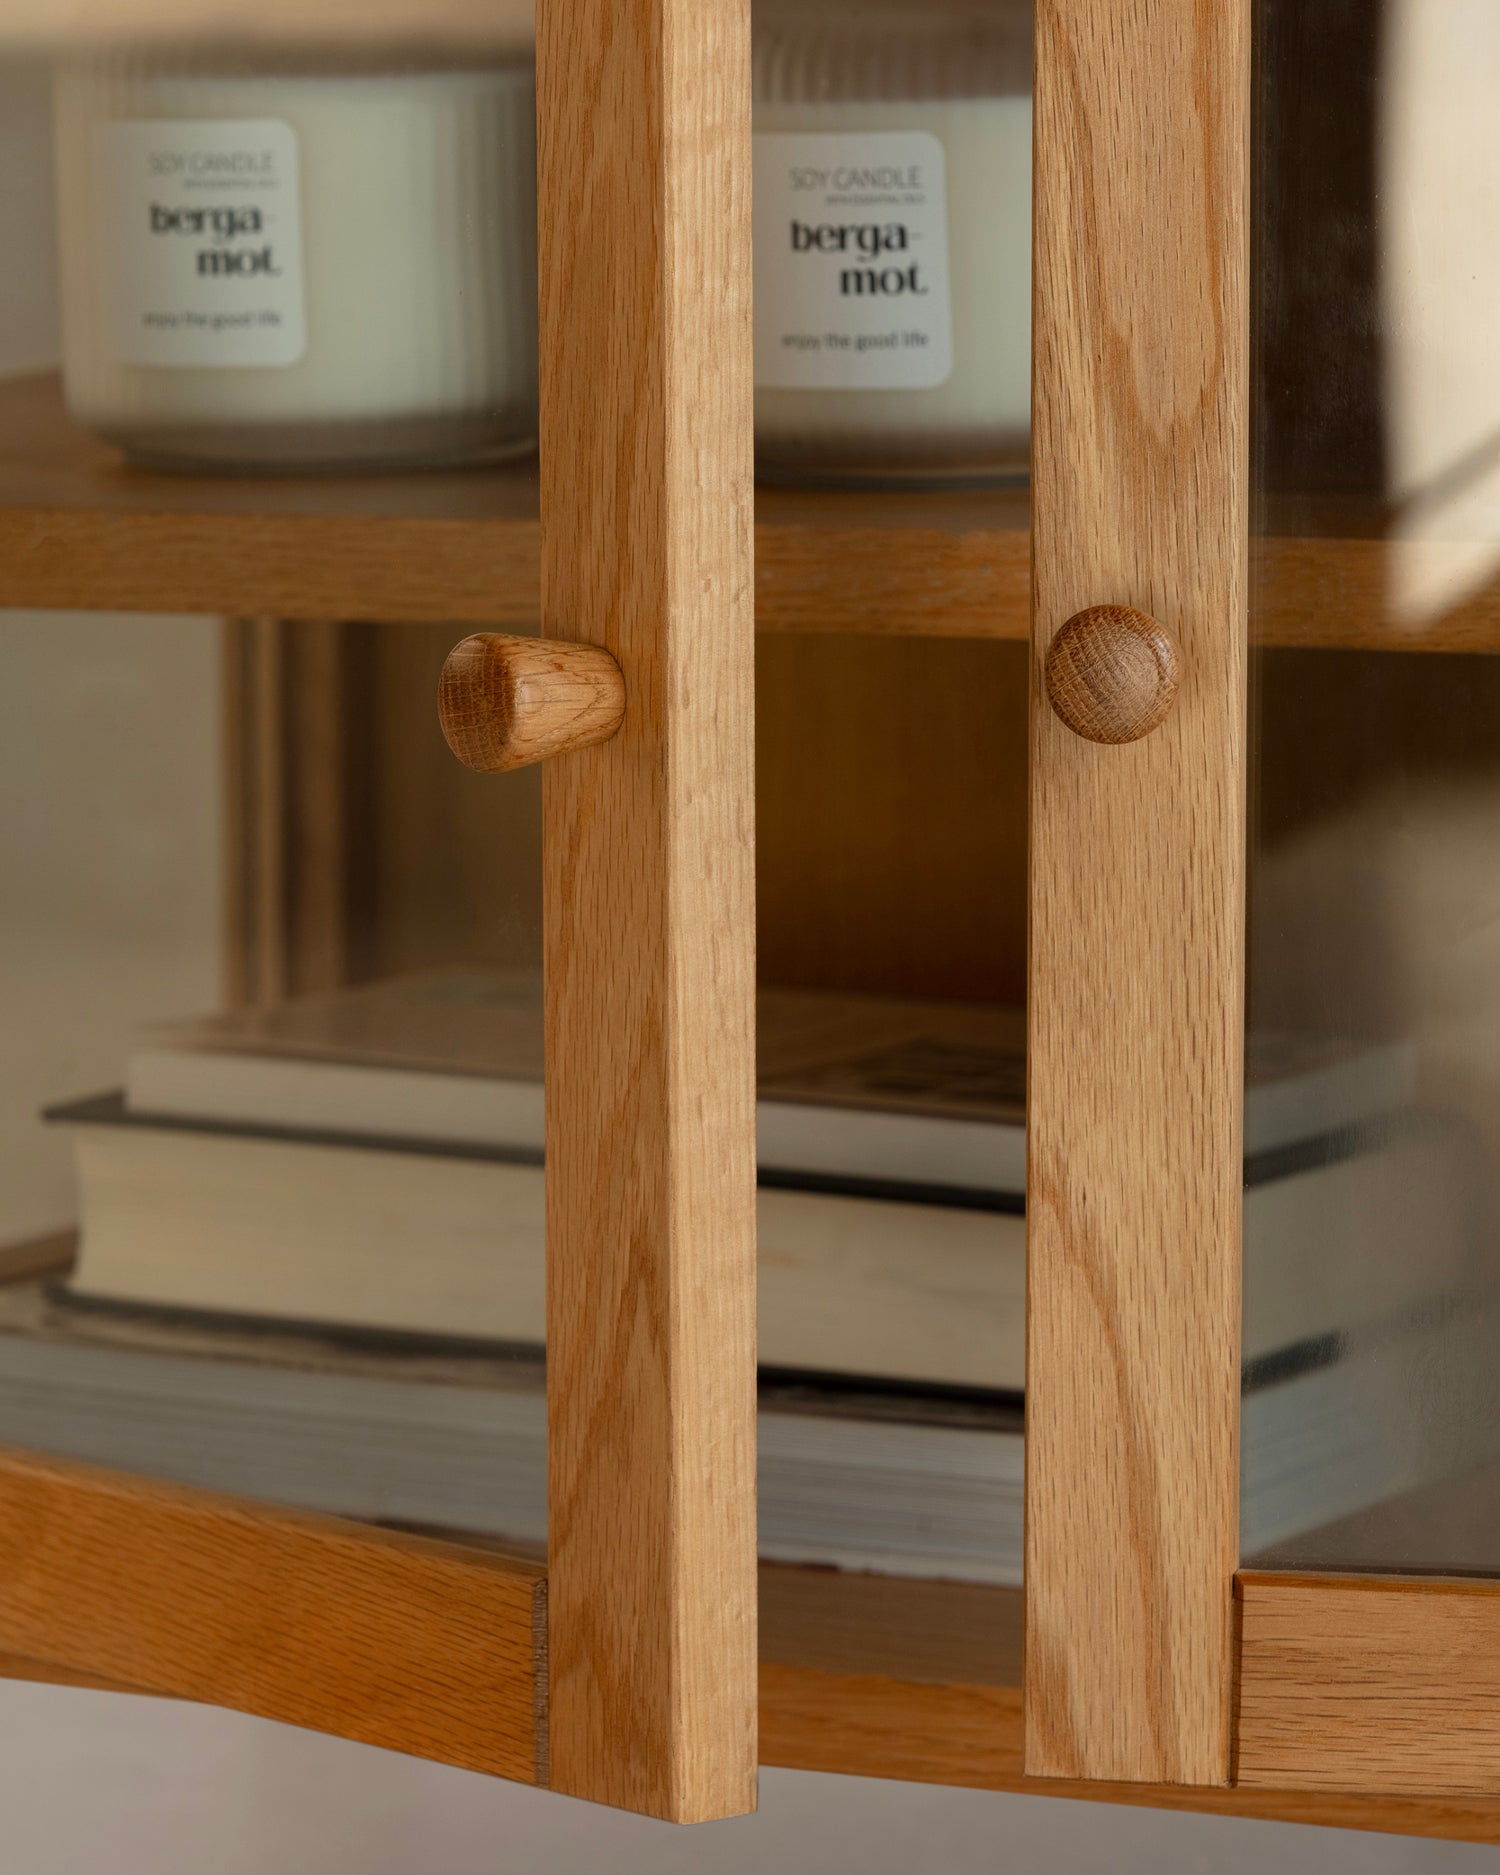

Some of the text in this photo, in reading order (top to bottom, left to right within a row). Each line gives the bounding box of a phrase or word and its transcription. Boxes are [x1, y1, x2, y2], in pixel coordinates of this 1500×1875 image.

[789, 165, 923, 190] SOY CANDLE
[790, 218, 923, 263] berga-
[826, 332, 851, 347] the
[855, 332, 898, 353] good
[903, 329, 929, 347] life
